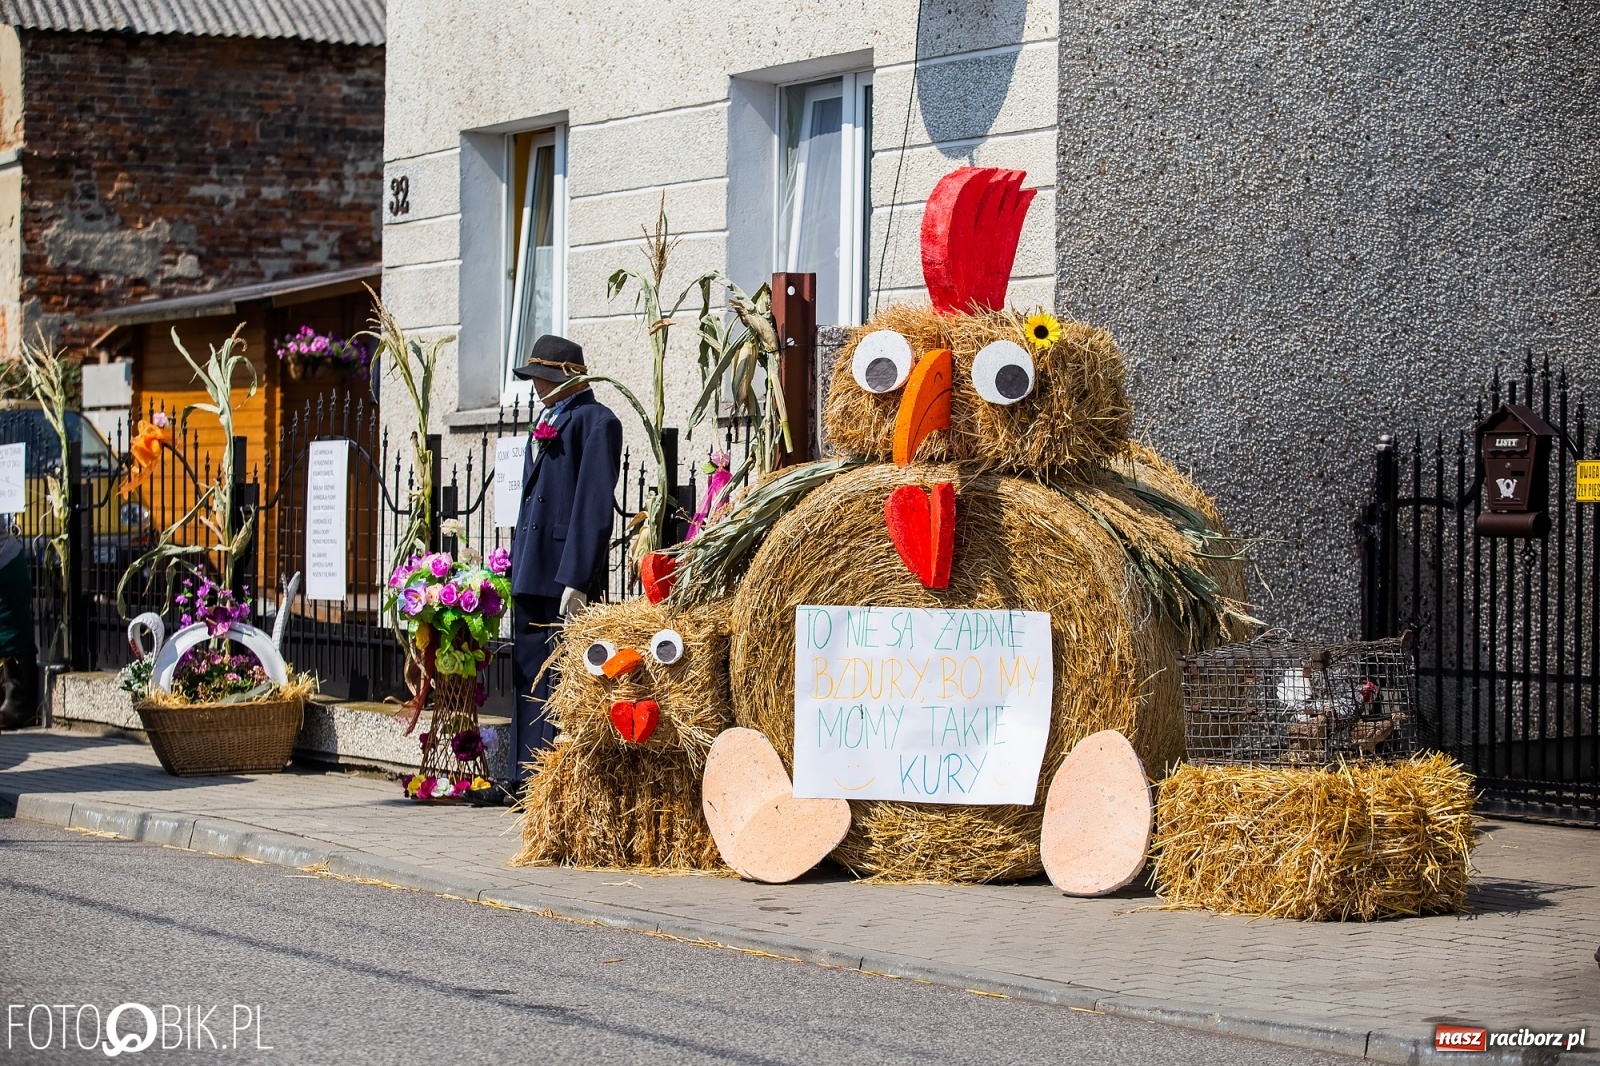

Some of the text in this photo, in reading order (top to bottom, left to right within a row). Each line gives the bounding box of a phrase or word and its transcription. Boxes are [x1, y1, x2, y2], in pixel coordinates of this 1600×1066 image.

[389, 175, 409, 217] 32
[1495, 438, 1519, 447] LISTY
[1579, 465, 1600, 479] UWAGA
[798, 608, 832, 649] TO
[847, 609, 883, 649] NIE
[808, 655, 1041, 703] BZDURY, BO MY
[921, 705, 1012, 747] TAKIE
[899, 751, 988, 795] KURY
